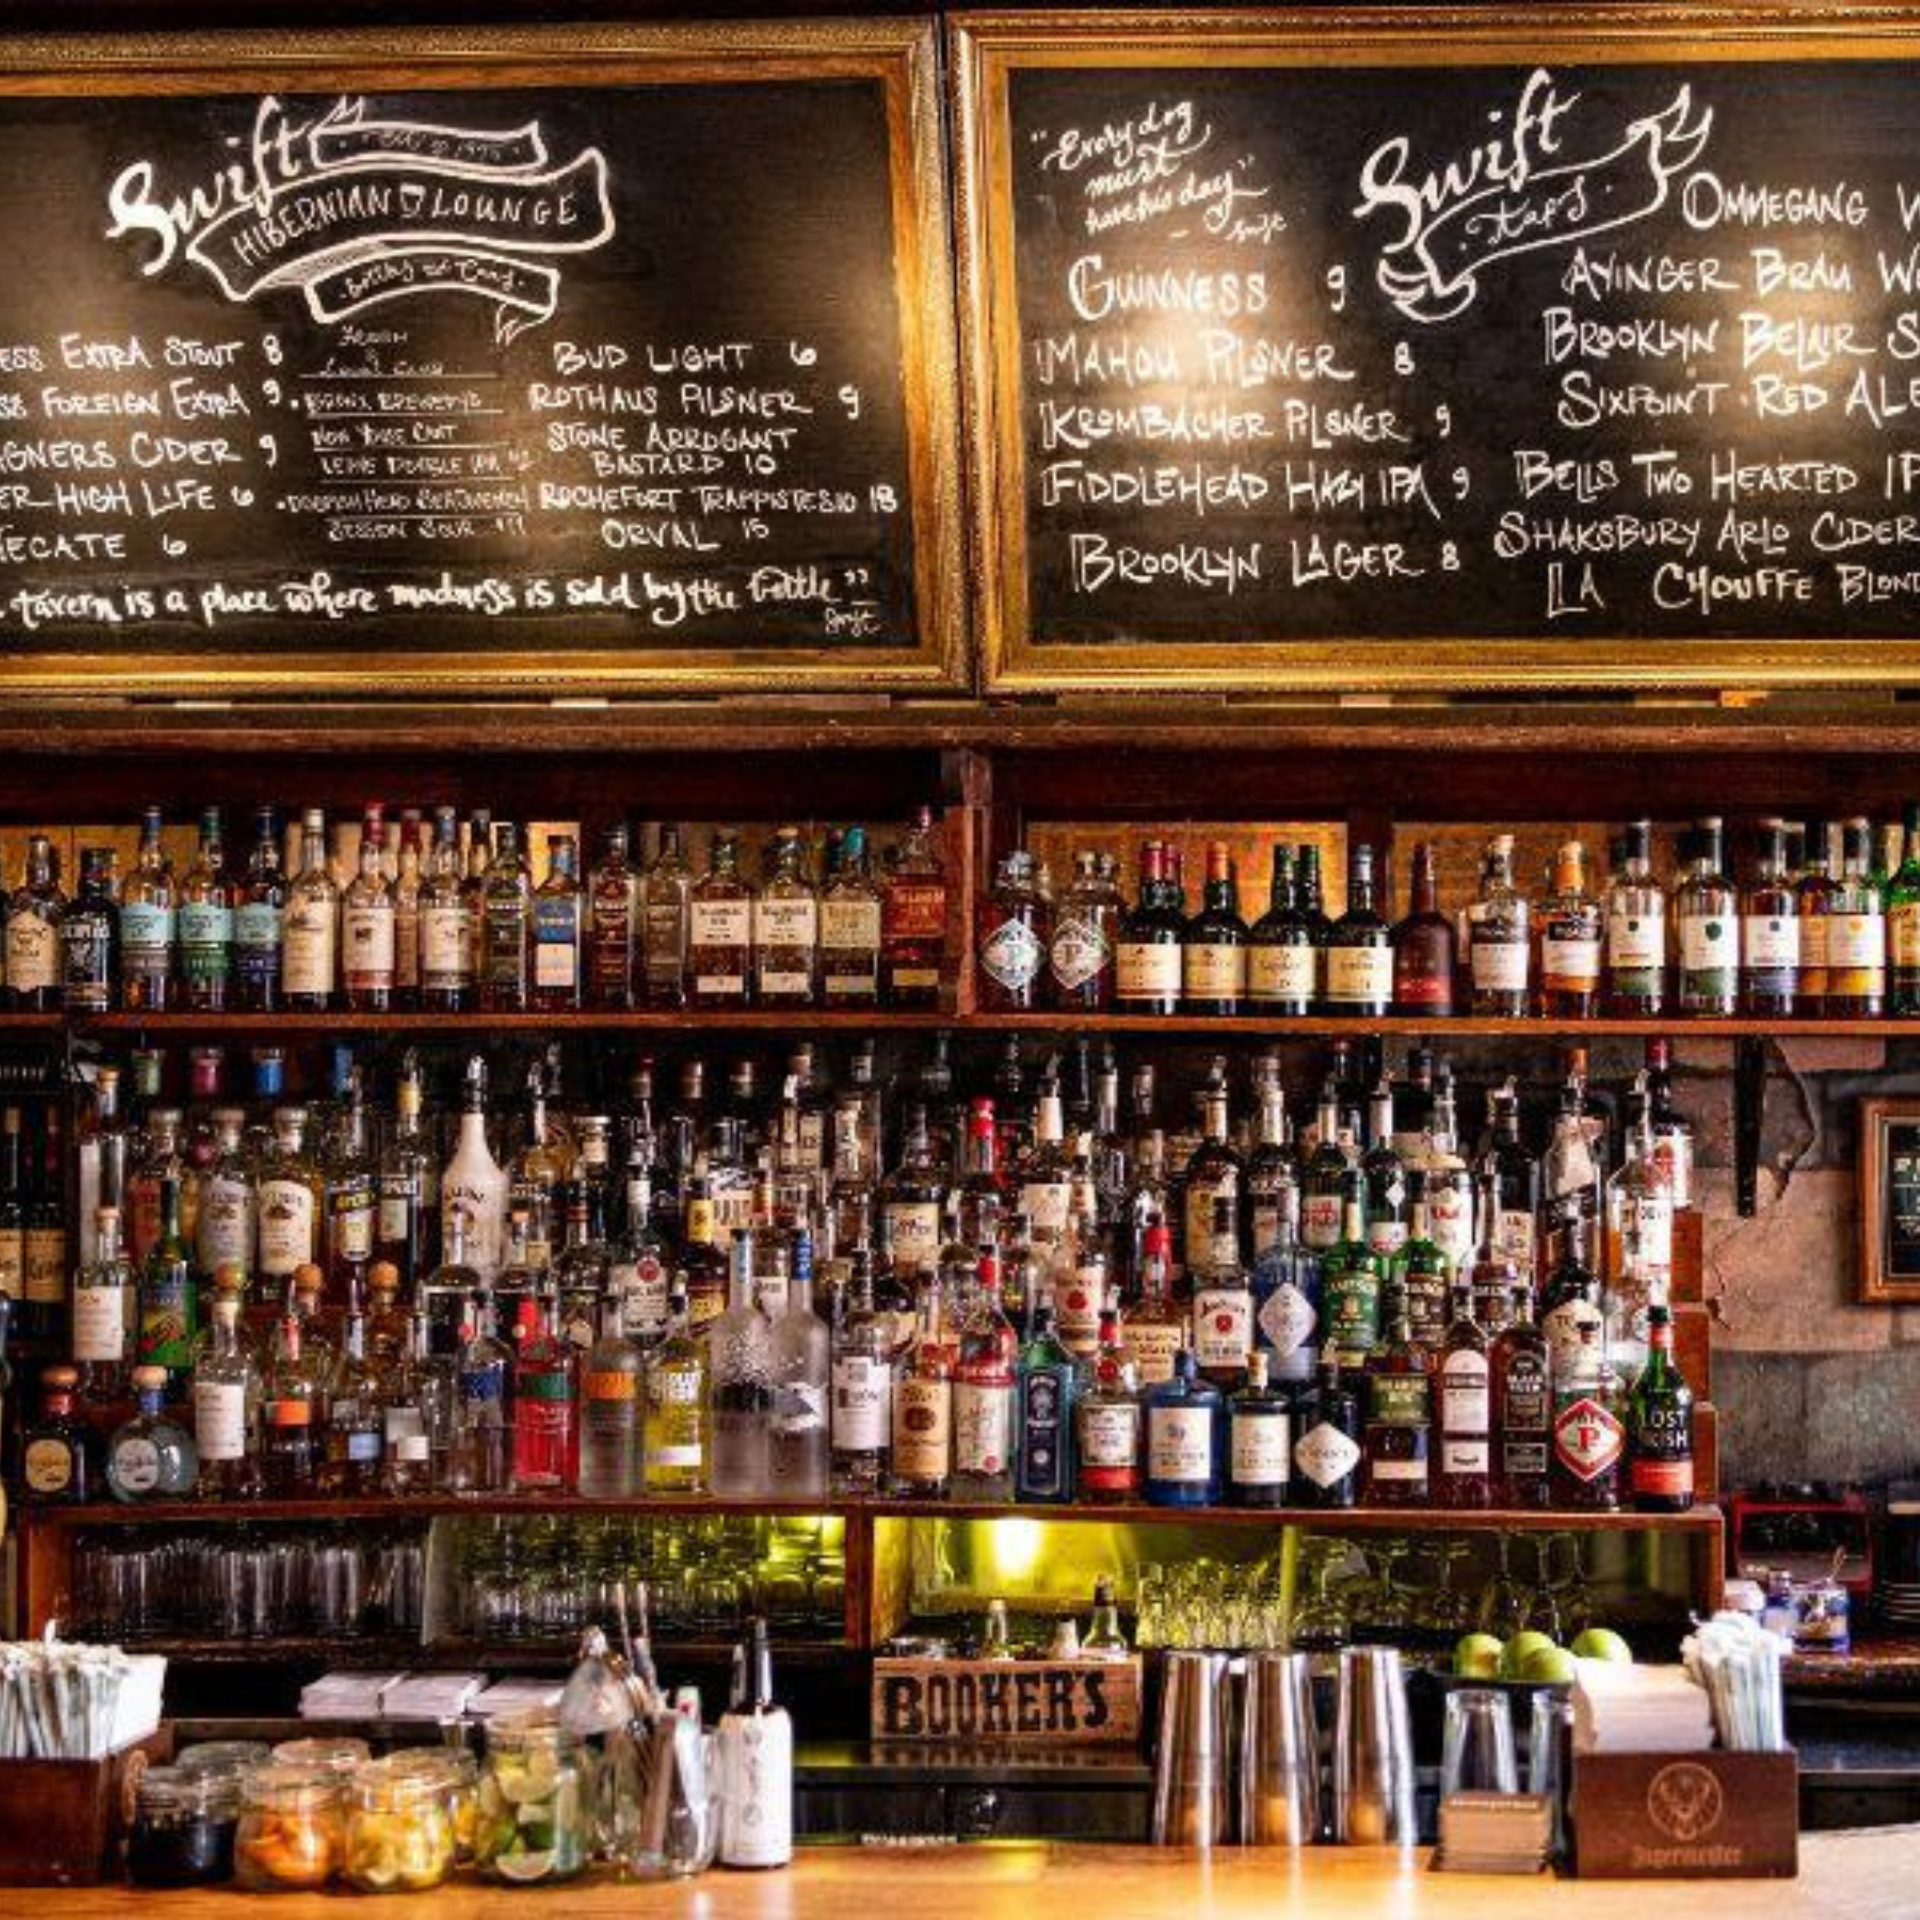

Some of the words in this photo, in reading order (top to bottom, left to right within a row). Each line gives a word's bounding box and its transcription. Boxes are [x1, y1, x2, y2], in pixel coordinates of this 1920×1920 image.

[1139, 102, 1193, 145] dog
[105, 96, 310, 275] Swift
[1354, 68, 1581, 254] Swift
[231, 188, 391, 267] HIBERNIAN
[432, 187, 578, 226] LOUNGE
[1682, 172, 1869, 229] OMMEGANG
[1068, 254, 1268, 321] GUINNESS
[1561, 246, 1741, 301] AYINGER
[60, 333, 152, 371] EXTRA
[165, 335, 244, 369] STOUT
[263, 334, 283, 366] 8
[553, 341, 629, 375] BUD
[647, 344, 753, 374] LIGHT
[1035, 334, 1178, 388] MAHOU
[1199, 329, 1355, 387] PILSNER
[1394, 342, 1415, 375] 8
[1543, 306, 1720, 366] BROOKLYN
[41, 386, 161, 417] FOREIGN
[170, 377, 250, 420] EXTRA
[528, 383, 659, 415] ROTHAUS
[681, 383, 814, 417] PILSNER
[838, 384, 860, 420] 9
[1040, 399, 1274, 449] KROMBACHER
[1285, 399, 1411, 449] PILSNER
[1558, 369, 1729, 428] SIXPOINT
[1751, 373, 1829, 421] RED
[131, 431, 243, 468] CIDER
[548, 421, 627, 452] STONE
[646, 421, 798, 453] ARROGANT
[590, 451, 725, 477] BASTARD
[745, 452, 778, 477] 10
[55, 479, 134, 517] HIGH
[141, 479, 216, 519] LIFE
[537, 483, 683, 514] ROCHEFORT
[1042, 459, 1269, 516] FIDDLEHEAD
[1379, 463, 1441, 520] IPA
[1631, 444, 1694, 498] TWO
[1712, 448, 1859, 502] HEARTED
[601, 519, 721, 551] ORVAL
[1494, 511, 1700, 558] SHAKSBURY
[1717, 508, 1791, 563] ARLO
[1811, 511, 1920, 552] CIDER
[1070, 533, 1261, 596] BROOKLYN
[1292, 533, 1425, 587] LAGER
[1442, 541, 1461, 570] 8
[1548, 562, 1605, 619] LA
[1653, 562, 1812, 616] CHOUFFE
[10, 588, 123, 631] tavern
[122, 584, 156, 619] is
[165, 590, 190, 613] a
[200, 582, 279, 628] place
[278, 570, 379, 619] where
[386, 570, 517, 616] madness
[524, 579, 555, 608] is
[566, 571, 641, 609] sold
[642, 572, 689, 627] by
[882, 1669, 1109, 1734] BOOKER'S
